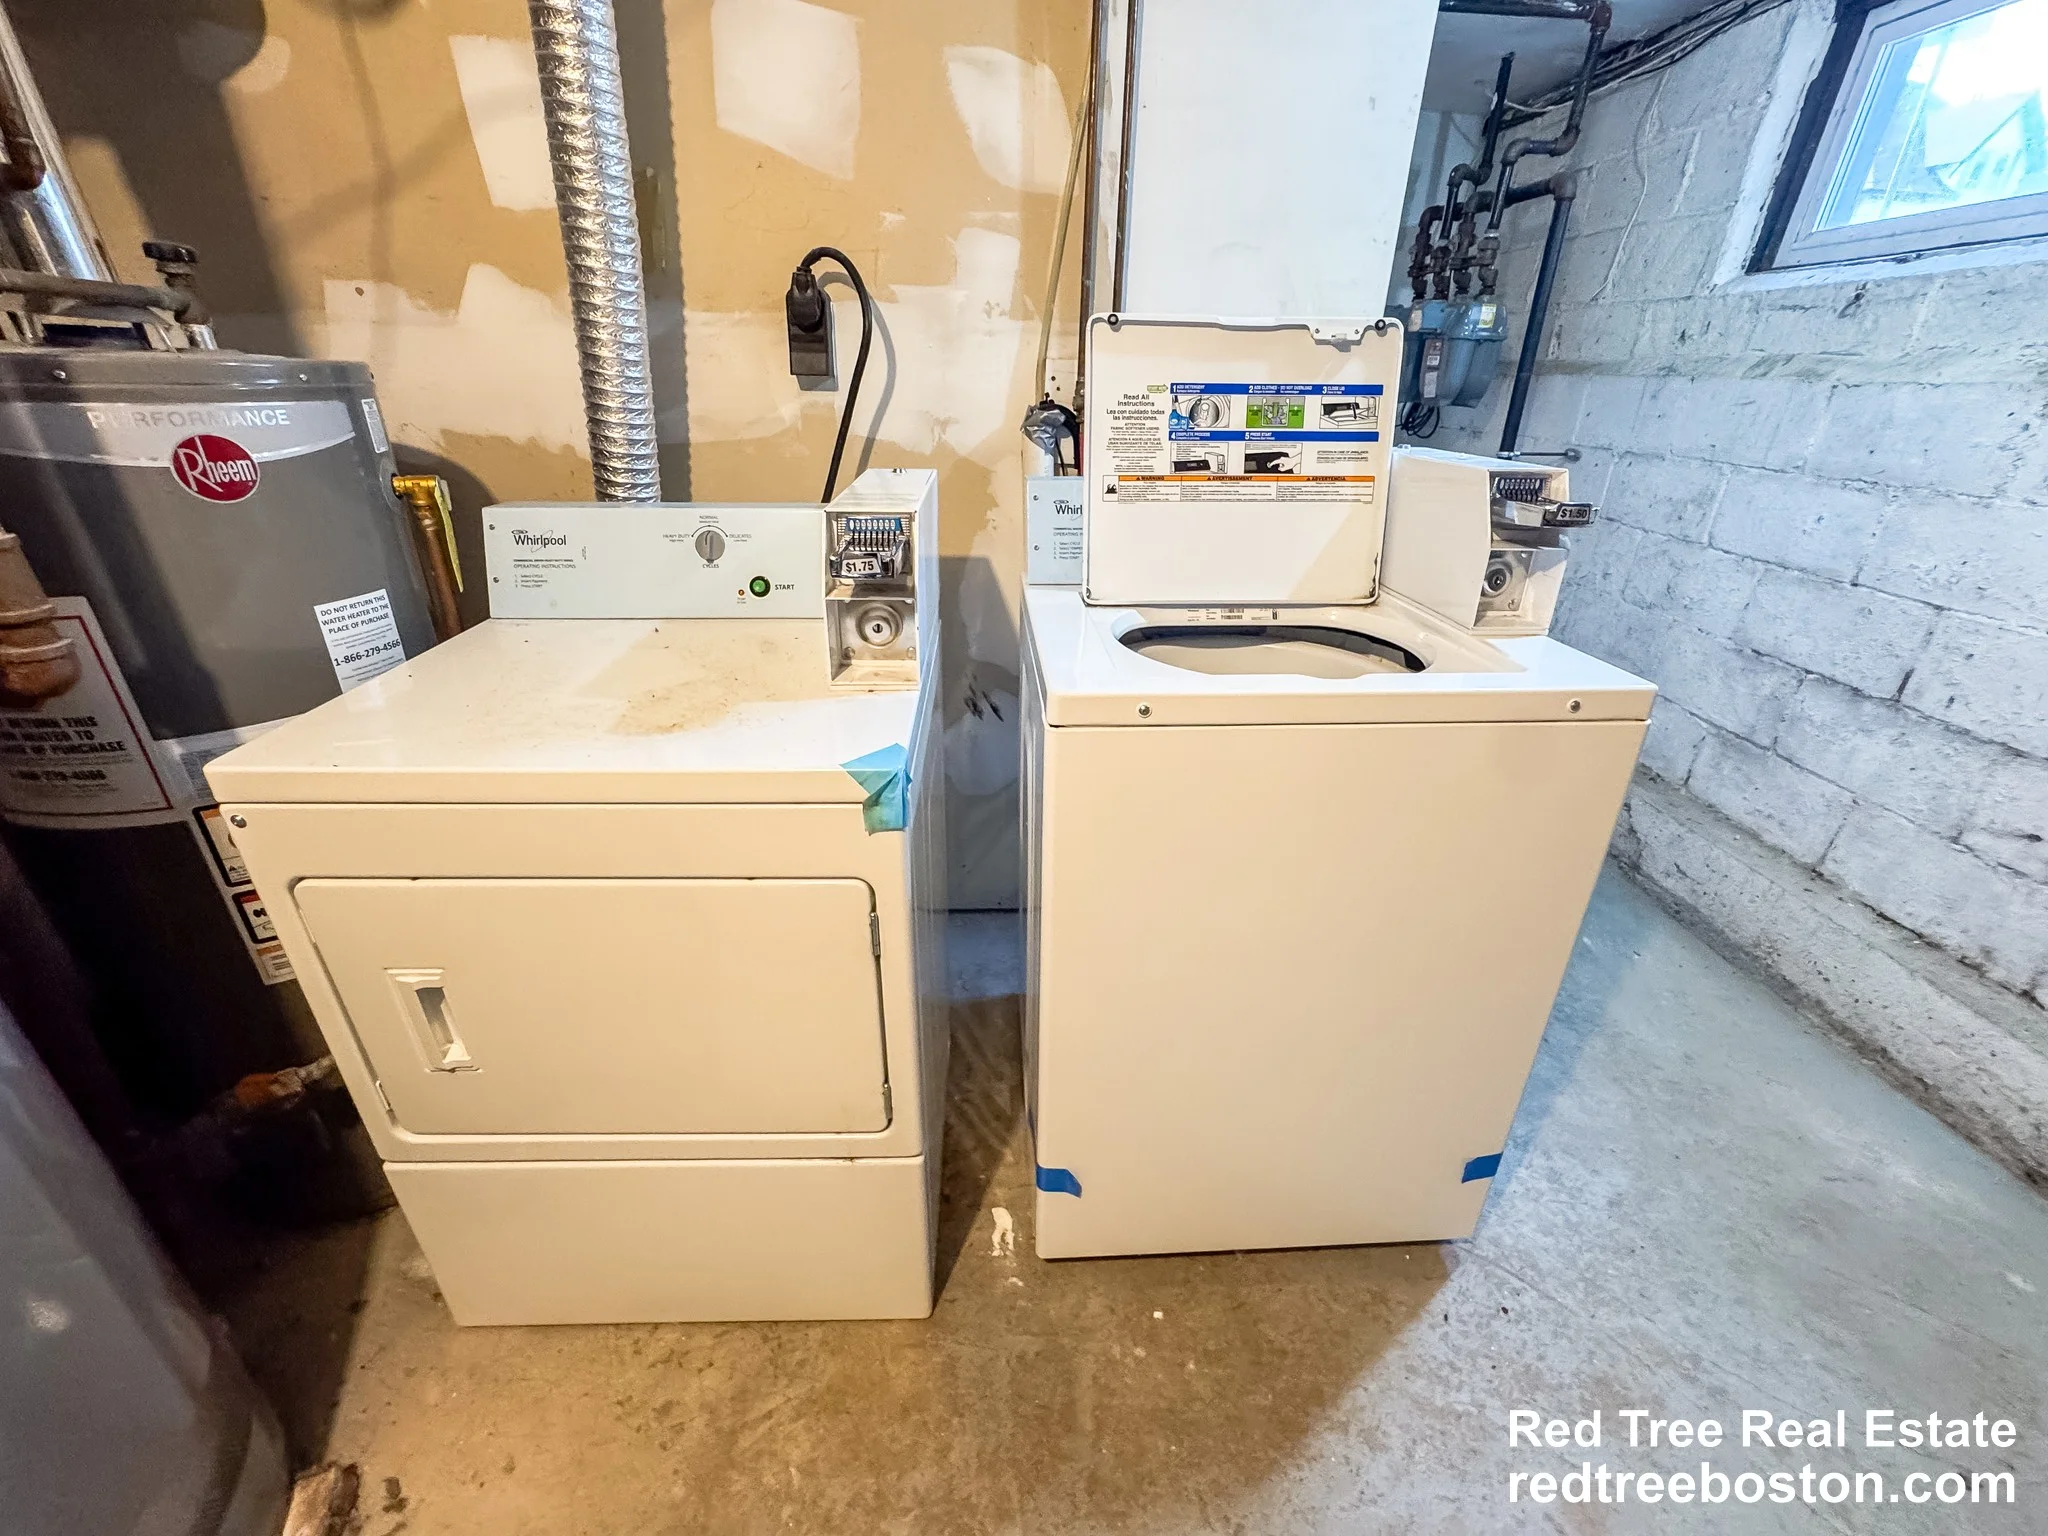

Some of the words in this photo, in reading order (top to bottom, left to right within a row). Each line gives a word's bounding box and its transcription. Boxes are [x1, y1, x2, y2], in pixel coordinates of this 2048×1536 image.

[1173, 384, 1176, 392] 1
[1249, 385, 1253, 393] 2
[1322, 386, 1327, 394] 3
[1171, 432, 1176, 440] 4
[176, 435, 257, 493] Rheem
[1055, 504, 1083, 515] Whirl
[1560, 508, 1587, 519] $1.50
[513, 534, 567, 549] Whirlpool
[845, 560, 874, 573] $1.75
[320, 608, 332, 617] DO
[333, 604, 348, 614] NOT
[349, 597, 374, 609] RETURN
[373, 594, 386, 603] THIS
[321, 615, 346, 626] WATER
[347, 608, 371, 620] HEATER
[371, 606, 379, 614] TO
[379, 602, 390, 610] THE
[328, 624, 350, 635] PLACE
[350, 621, 360, 629] OF
[361, 612, 389, 626] PURCHASE
[334, 638, 401, 667] 1-866-279-4566
[62, 715, 98, 728] THIS
[73, 729, 95, 740] TO
